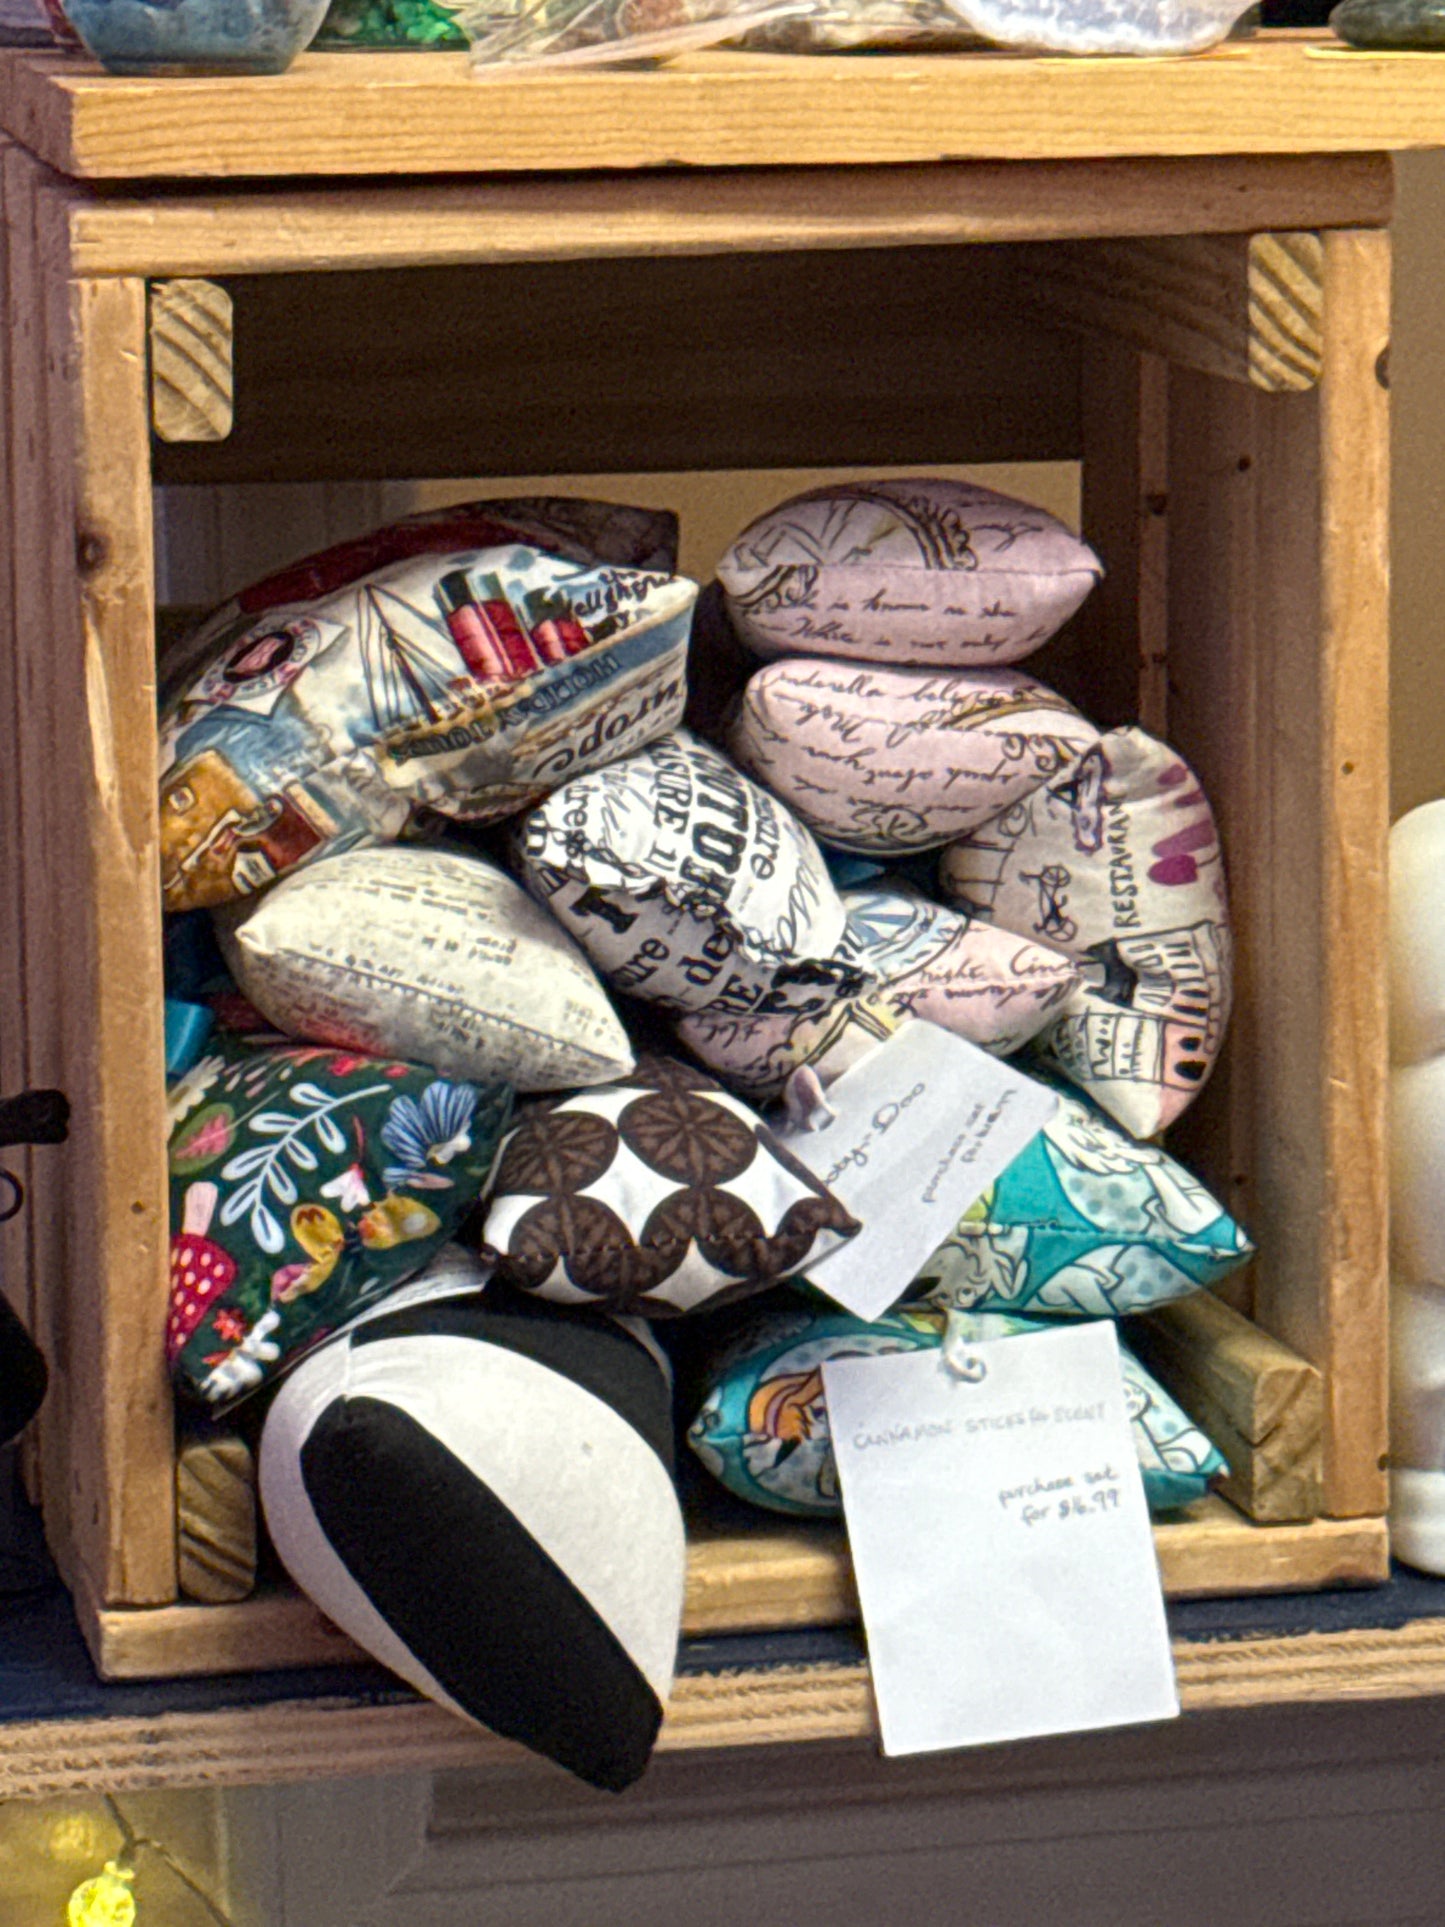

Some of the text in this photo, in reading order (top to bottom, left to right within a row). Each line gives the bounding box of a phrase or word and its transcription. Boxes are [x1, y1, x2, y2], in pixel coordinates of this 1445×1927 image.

[533, 682, 683, 779] urope
[823, 1082, 926, 1187] oby-Doo
[1020, 1503, 1051, 1527] for
